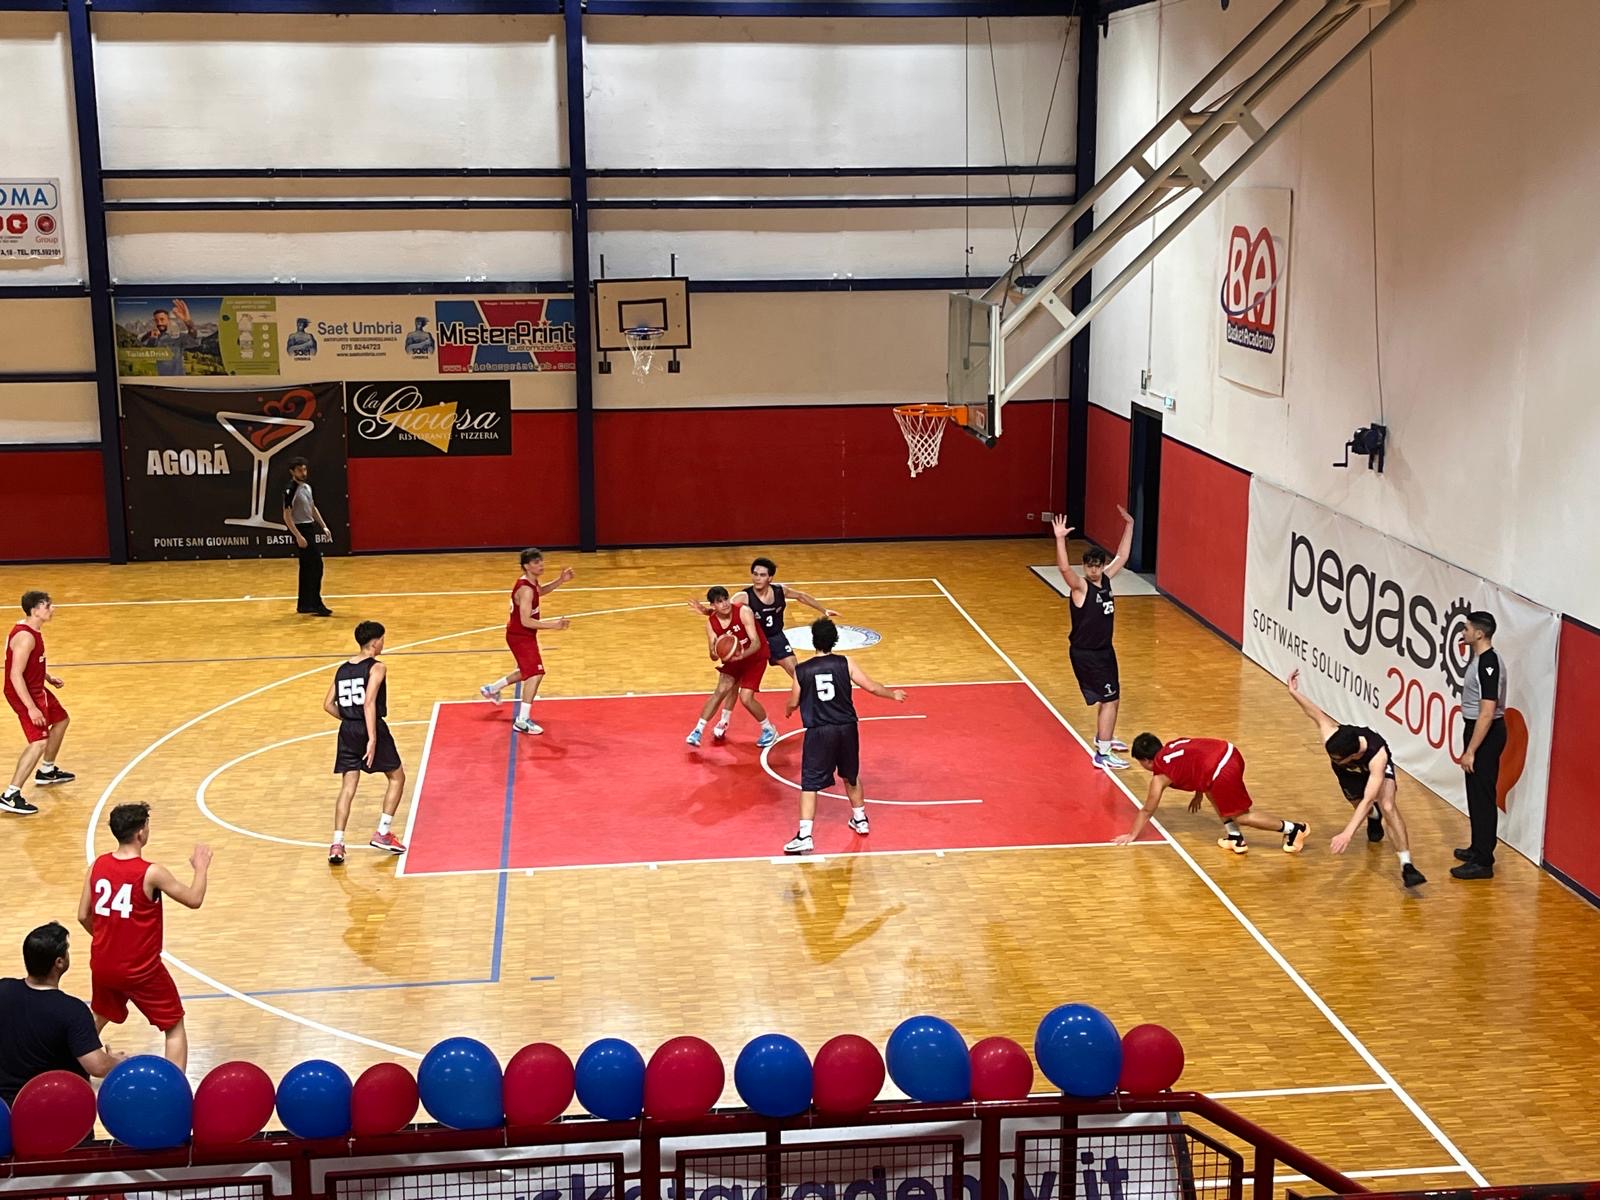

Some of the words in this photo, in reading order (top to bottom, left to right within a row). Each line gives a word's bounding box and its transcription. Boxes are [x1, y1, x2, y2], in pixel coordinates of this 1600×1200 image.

[1228, 229, 1276, 328] BA
[317, 322, 348, 335] Saet
[353, 321, 402, 334] Umbria
[439, 321, 574, 345] MisterPrint
[353, 384, 501, 440] Gioiosa
[399, 432, 452, 441] RISTORANTE
[460, 432, 499, 440] PIZZERIA
[147, 443, 230, 476] AGORÁ
[154, 538, 184, 547] PONTE
[186, 537, 204, 547] SAN
[206, 536, 249, 547] GIOVANNI
[266, 534, 295, 545] BASTI
[315, 534, 333, 544] BRA
[765, 616, 774, 627] 3
[1103, 600, 1115, 615] 25
[1253, 609, 1308, 662] SOFTWARE
[1312, 647, 1380, 709] SOLUTIONS
[338, 677, 366, 707] 55
[815, 673, 836, 702] 5
[94, 878, 134, 919] 24
